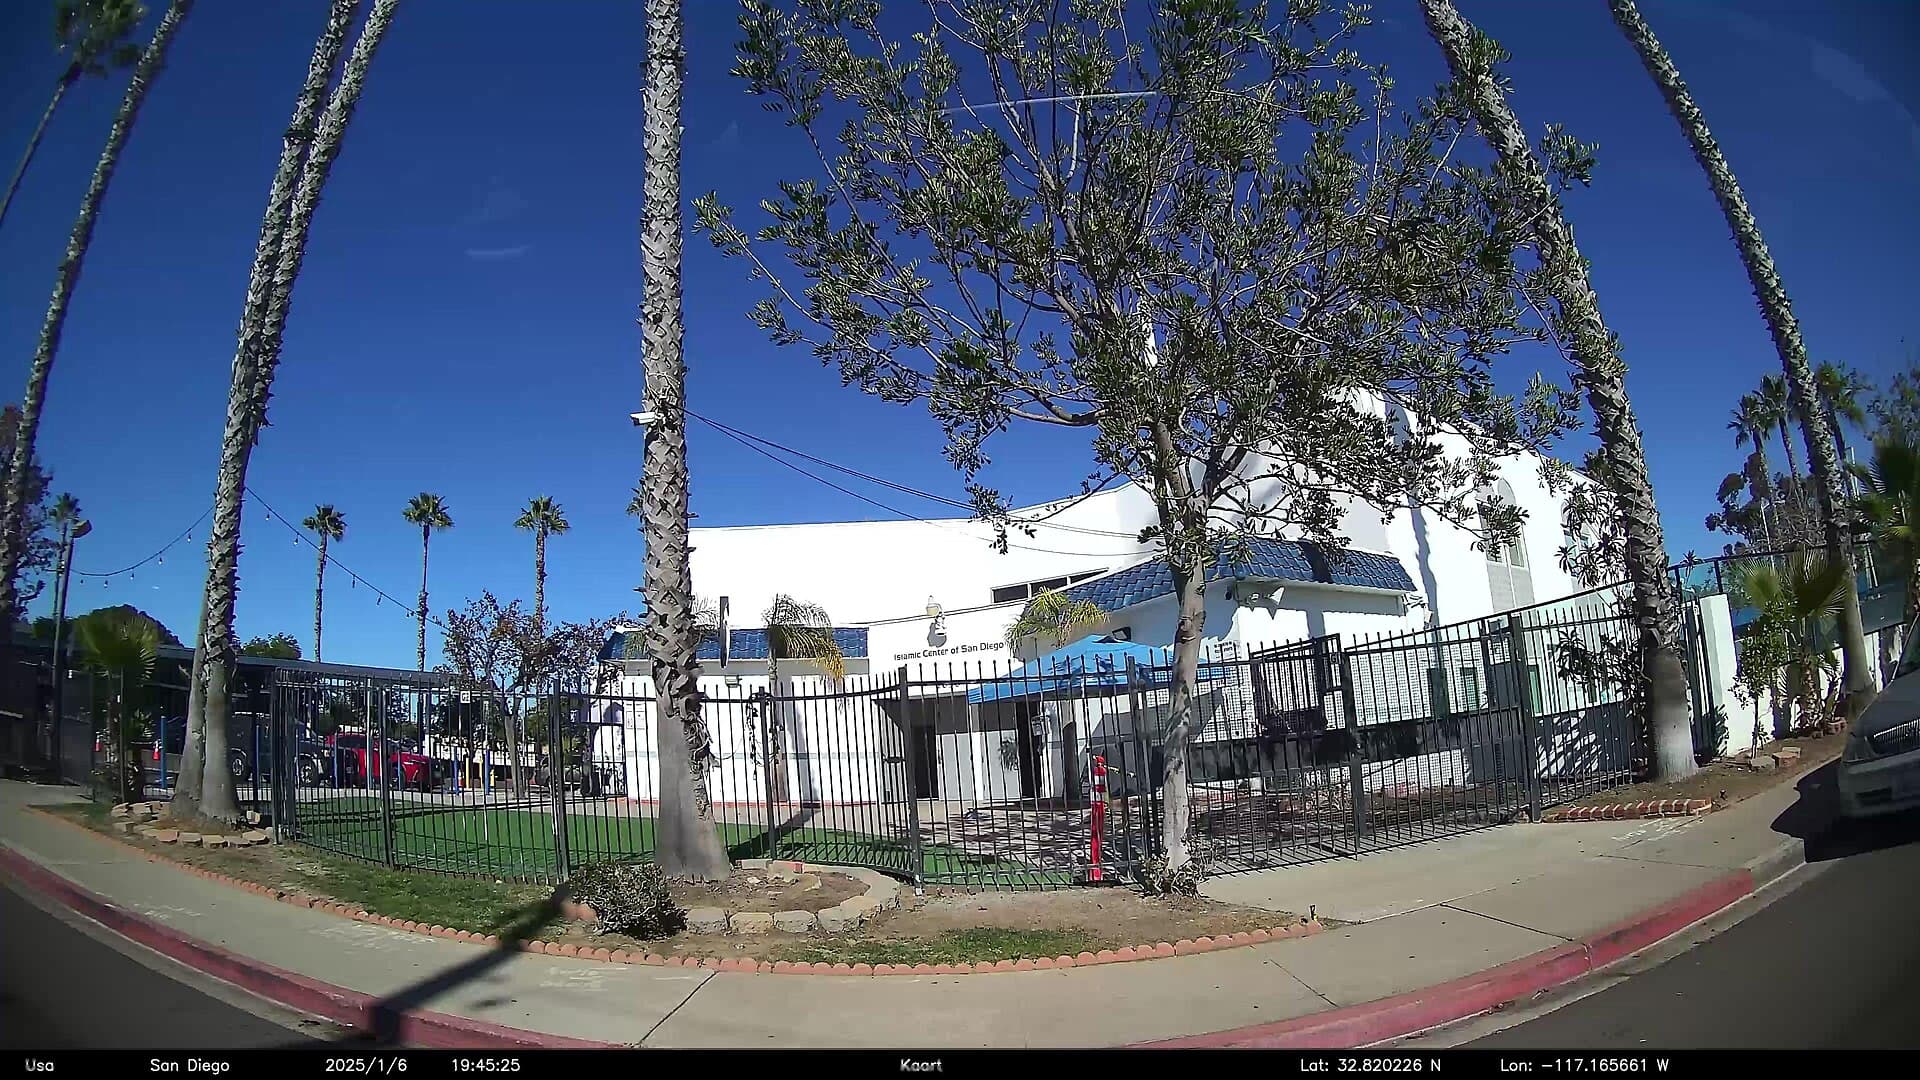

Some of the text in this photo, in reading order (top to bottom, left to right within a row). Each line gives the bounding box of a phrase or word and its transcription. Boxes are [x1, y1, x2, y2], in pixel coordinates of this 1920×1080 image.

[894, 641, 1005, 661] Islamic Center of San Diego
